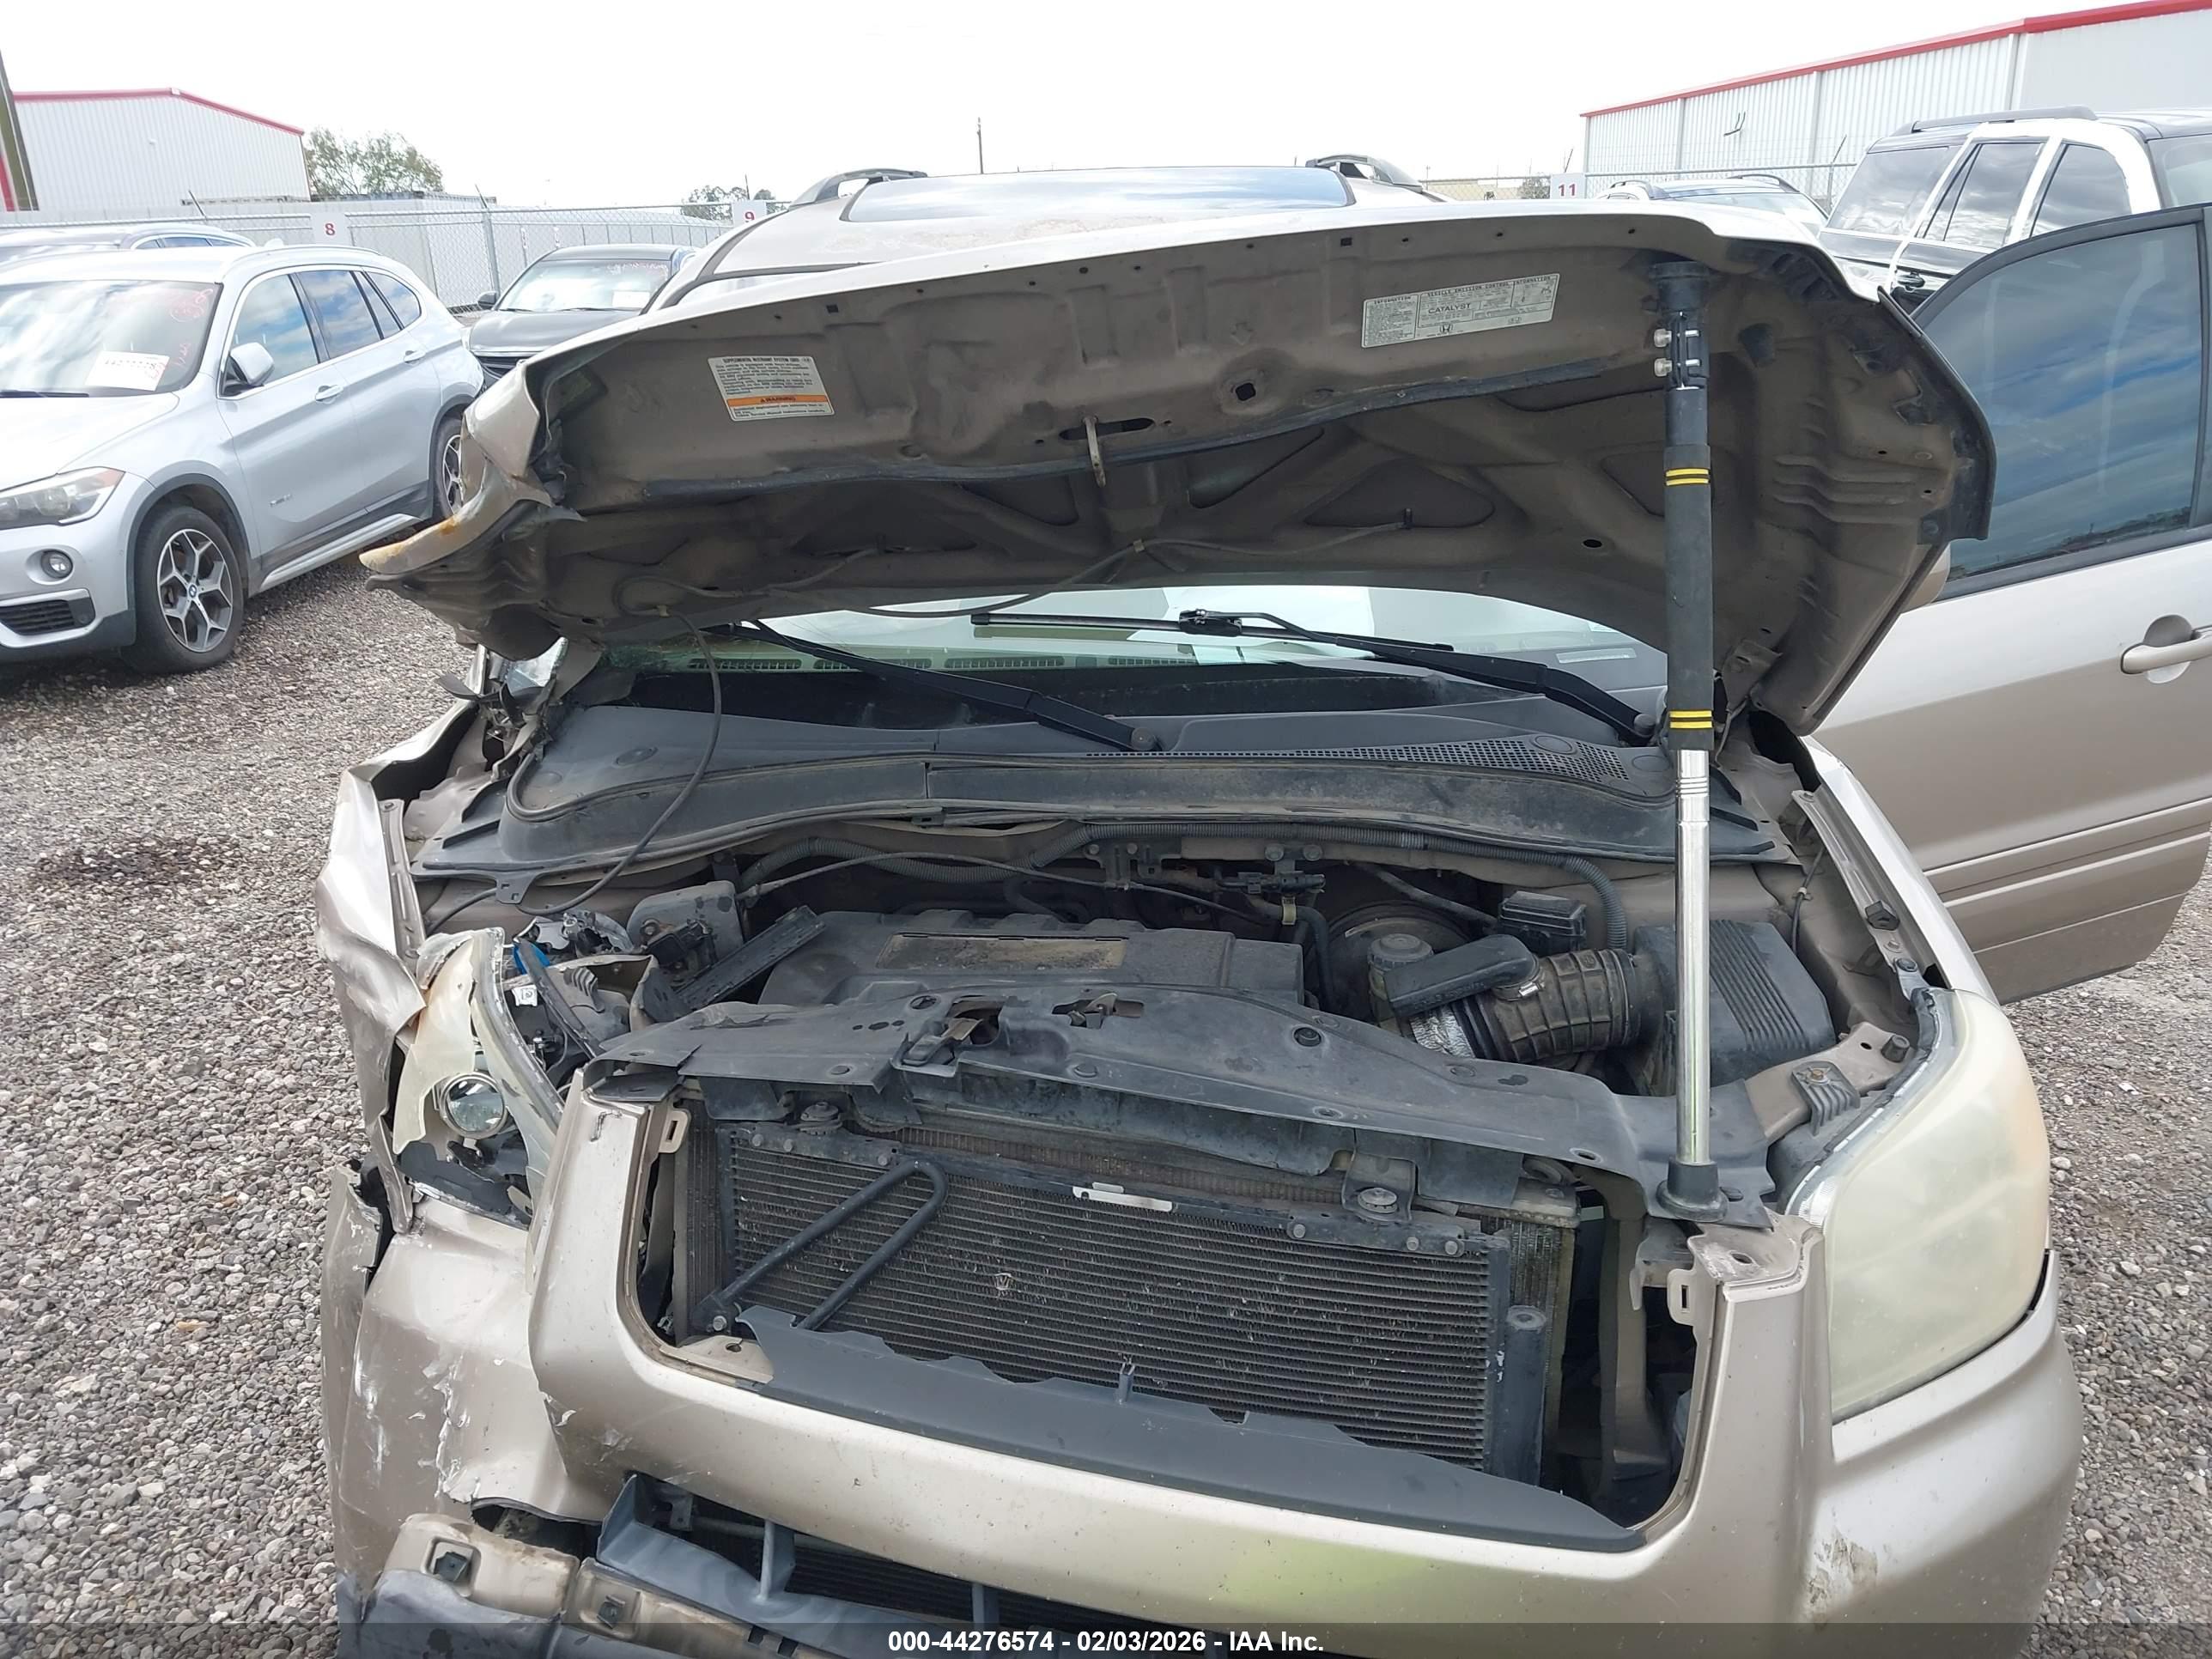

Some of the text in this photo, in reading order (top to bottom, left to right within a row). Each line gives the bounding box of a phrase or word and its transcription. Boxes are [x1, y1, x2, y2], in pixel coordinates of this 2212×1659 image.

[1559, 183, 1576, 197] 11
[325, 222, 336, 236] 8
[1428, 302, 1471, 314] CATALYST
